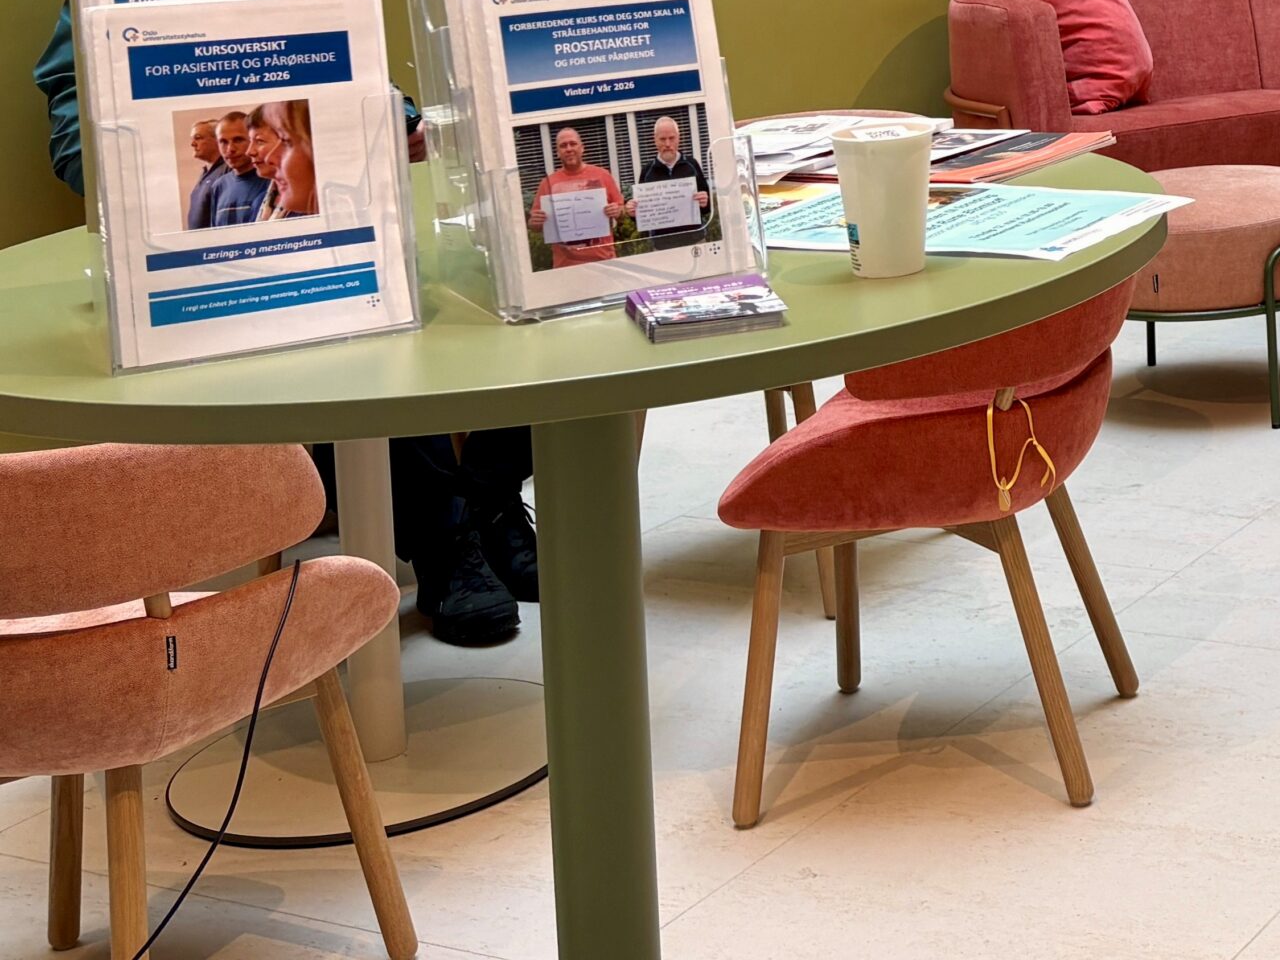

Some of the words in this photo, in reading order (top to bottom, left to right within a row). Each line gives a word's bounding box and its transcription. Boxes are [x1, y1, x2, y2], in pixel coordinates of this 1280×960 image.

[509, 18, 575, 32] FORBEREDENDE
[576, 15, 597, 24] KURS
[599, 14, 614, 22] FOR
[616, 12, 632, 21] DEG
[633, 10, 652, 19] SOM
[653, 9, 672, 17] SKAL
[673, 7, 685, 15] HA
[552, 24, 632, 39] STRÅLEBEHANDLING
[633, 22, 649, 30] FOR
[194, 40, 287, 57] KURSOVERSIKT
[554, 34, 651, 54] PROSTATAKREFT
[145, 65, 170, 77] FOR
[173, 60, 239, 74] PASIENTER
[242, 58, 261, 69] OG
[264, 52, 336, 67] PÅRØRENDE
[554, 59, 568, 68] OG
[569, 57, 586, 66] FOR
[587, 56, 607, 64] DINE
[608, 49, 655, 62] PÅRØRENDE
[197, 77, 232, 87] Vinter
[242, 73, 260, 84] vår
[263, 71, 290, 82] 2026
[597, 83, 611, 93] Vår
[613, 81, 635, 91] 2026
[203, 250, 242, 260] Lærings-
[244, 247, 257, 256] og
[258, 238, 322, 253] mestringskurs
